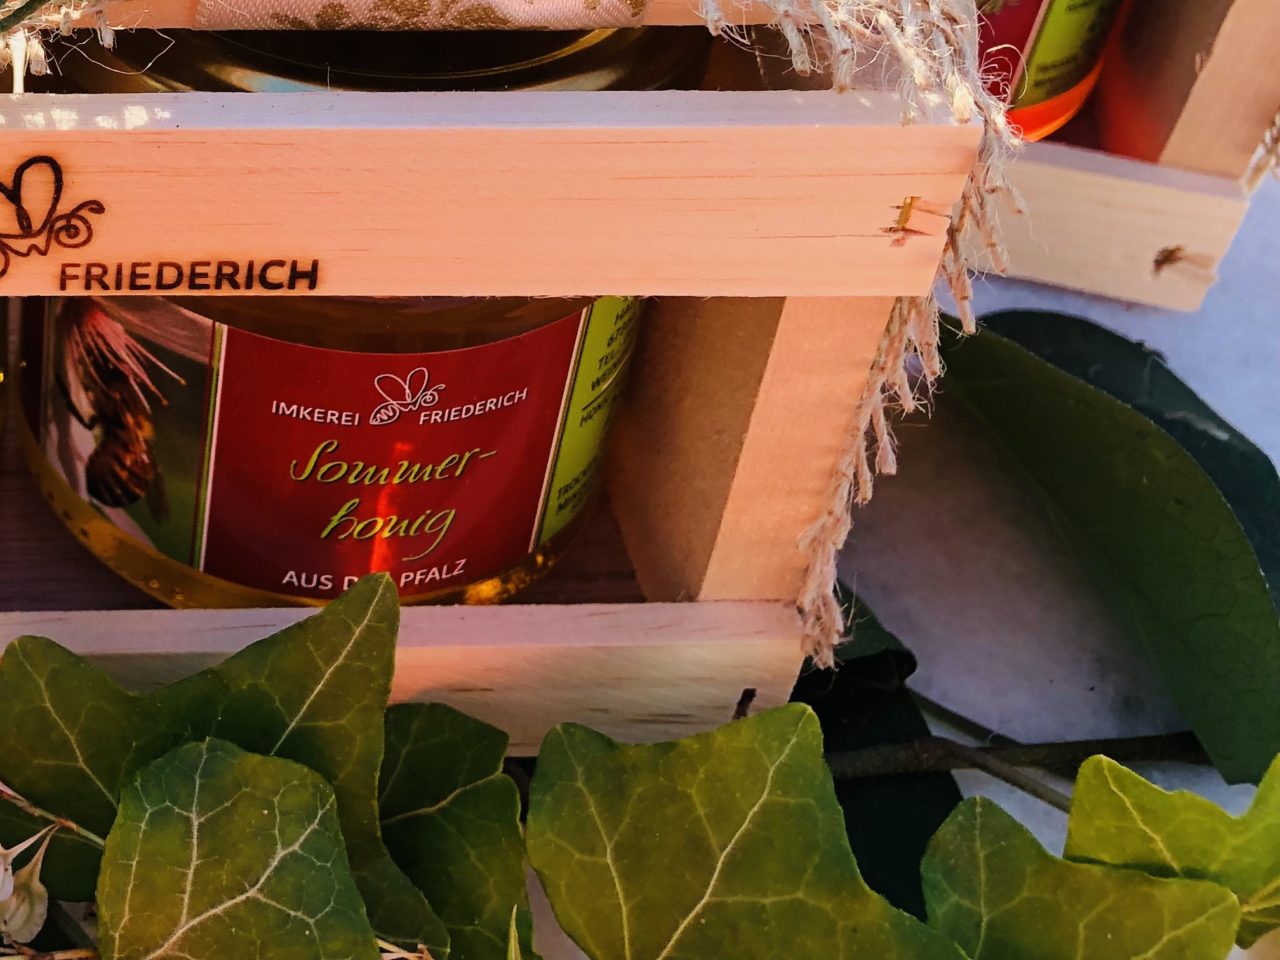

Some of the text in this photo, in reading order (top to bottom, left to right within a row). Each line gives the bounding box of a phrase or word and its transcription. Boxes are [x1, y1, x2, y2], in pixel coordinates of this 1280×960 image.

[59, 259, 319, 291] FRIEDERICH
[271, 387, 528, 426] IMKEREI FRIEDERICH
[289, 439, 498, 485] Sommer-
[320, 497, 456, 561] honig
[282, 570, 333, 590] AUS
[399, 558, 468, 588] PFALZ
